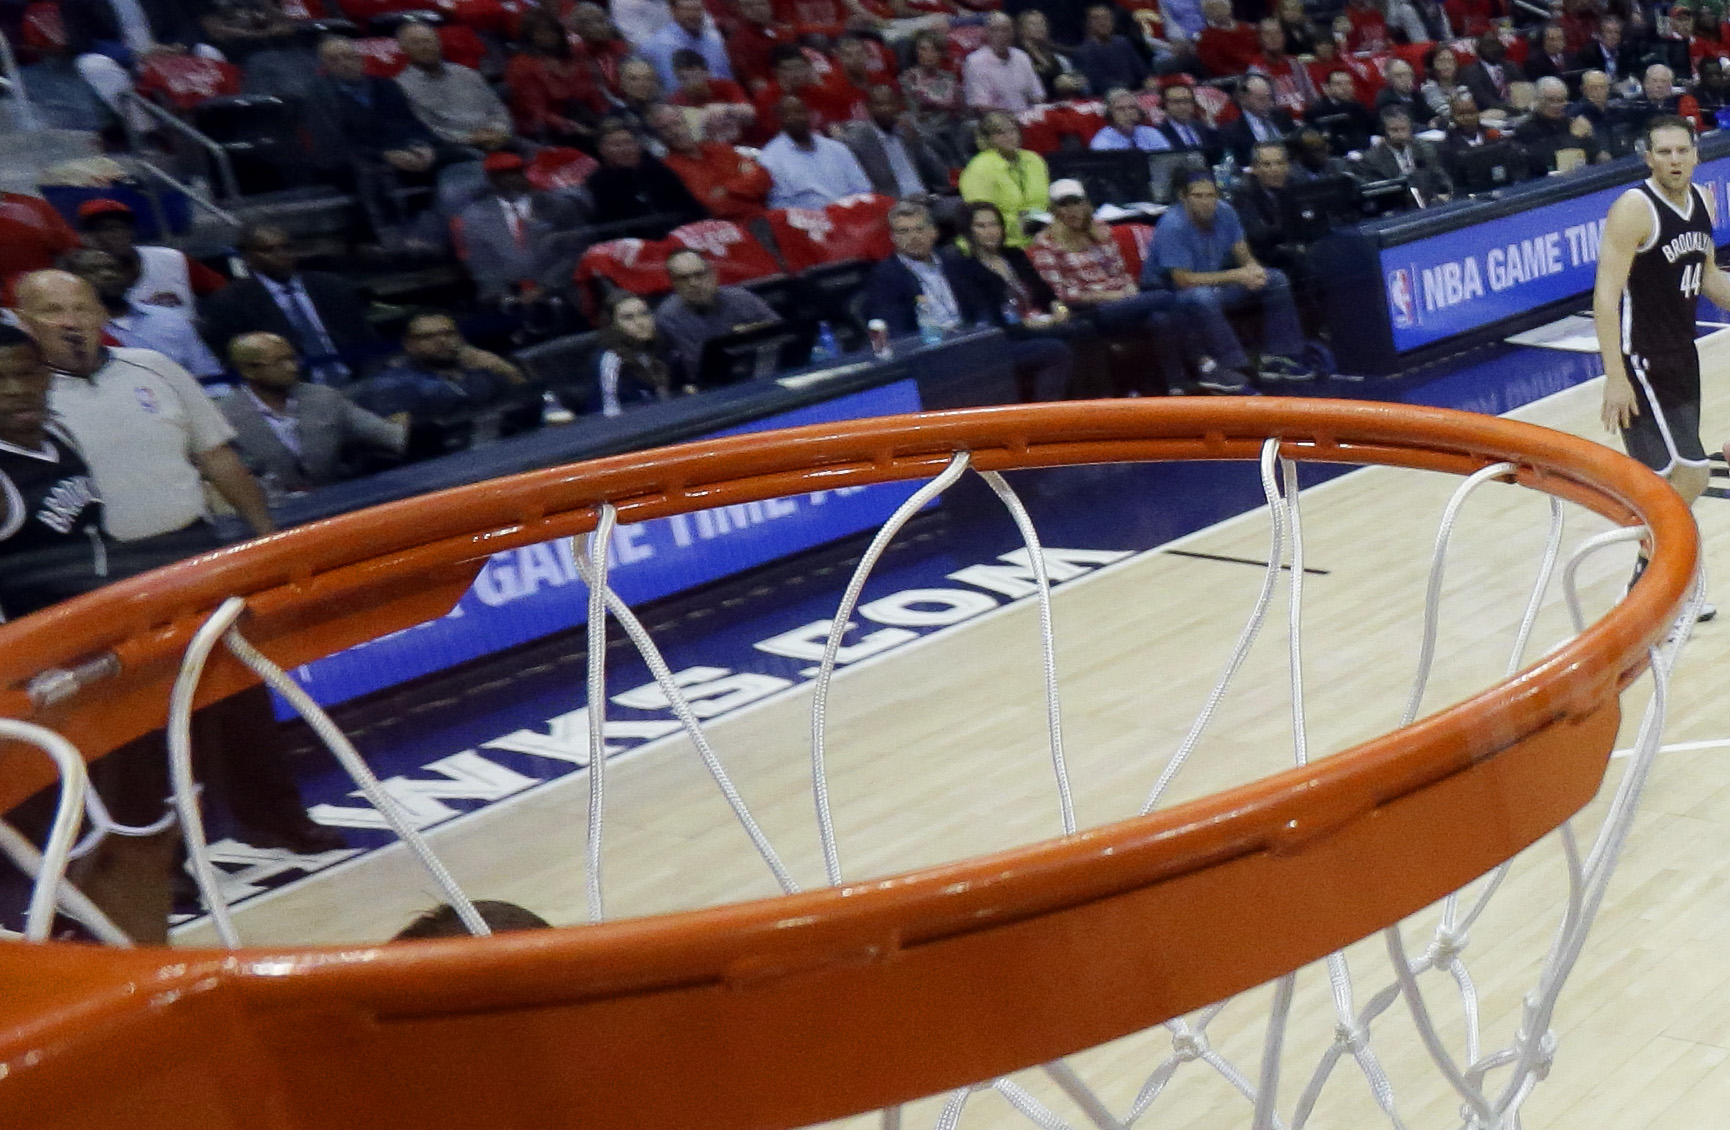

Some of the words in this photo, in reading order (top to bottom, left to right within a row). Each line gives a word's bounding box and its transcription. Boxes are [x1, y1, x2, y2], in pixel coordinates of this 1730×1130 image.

[1422, 255, 1485, 312] NBA
[1486, 231, 1565, 292] GAME
[1680, 262, 1703, 299] 44
